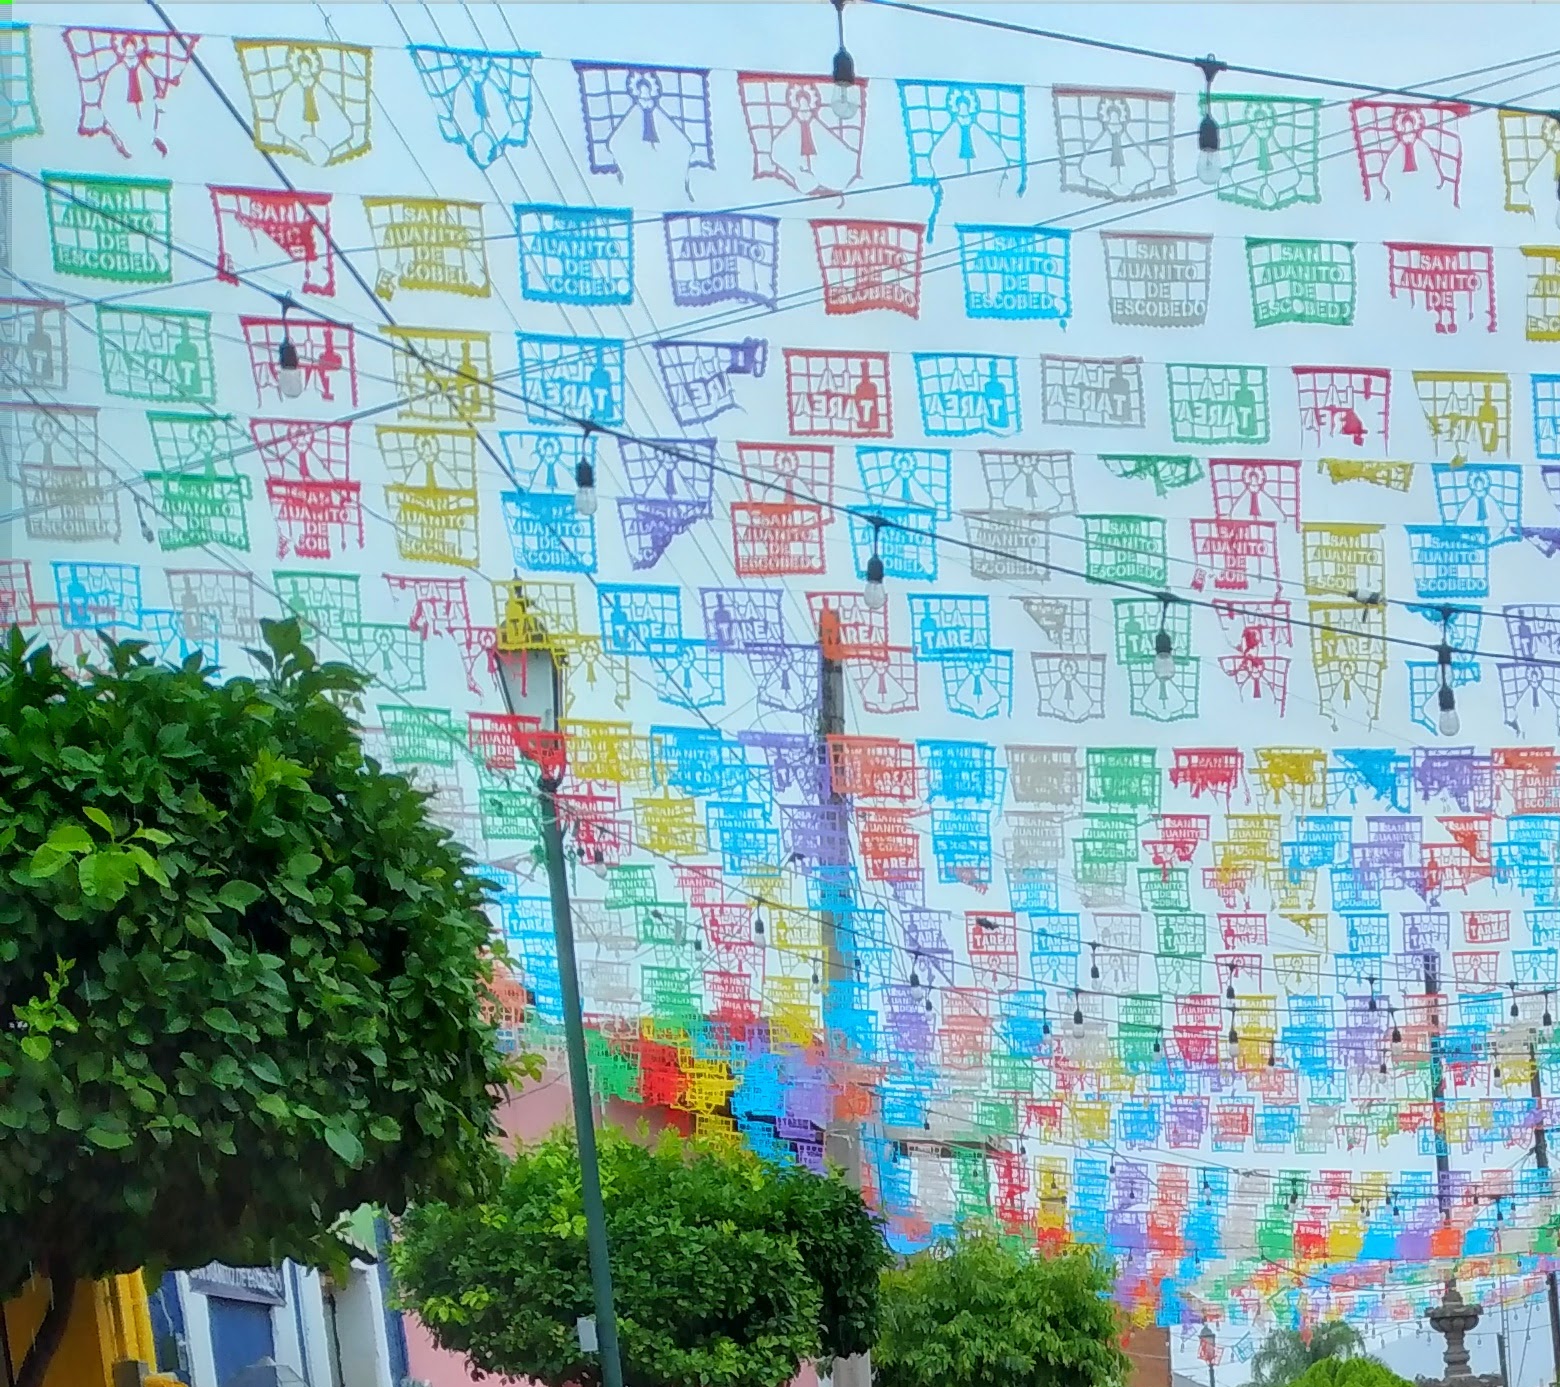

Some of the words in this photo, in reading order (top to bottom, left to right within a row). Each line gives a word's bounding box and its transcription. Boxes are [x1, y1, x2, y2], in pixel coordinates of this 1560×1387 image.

[86, 188, 131, 207] SAN
[62, 212, 158, 231] JUANITO
[403, 207, 449, 222] SAN
[700, 220, 742, 236] SAN
[846, 228, 890, 244] SAN
[101, 234, 128, 249] DE
[384, 227, 472, 248] JUANITO
[994, 237, 1035, 252] SAN
[418, 246, 444, 262] DE
[530, 239, 621, 257] JUANITO
[679, 243, 765, 263] JUANITO
[1136, 244, 1176, 258] SAN
[1281, 246, 1321, 262] SAN
[712, 259, 736, 273] DE
[831, 250, 908, 266] JUANITO
[1421, 254, 1458, 270] SAN
[566, 260, 593, 275] DE
[972, 258, 1058, 275] JUANITO
[1118, 263, 1198, 279] JUANITO
[1262, 266, 1345, 282] JUANITO
[857, 269, 881, 283] DE
[1004, 277, 1029, 291] DE
[1401, 272, 1482, 290] JUANITO
[829, 284, 917, 306] ESCOBEDO
[1149, 283, 1171, 298] DE
[1293, 284, 1315, 298] DE
[1430, 292, 1454, 307] DE
[1113, 301, 1206, 316] ESCOBEDO
[1258, 301, 1351, 319] ESCOBEDO
